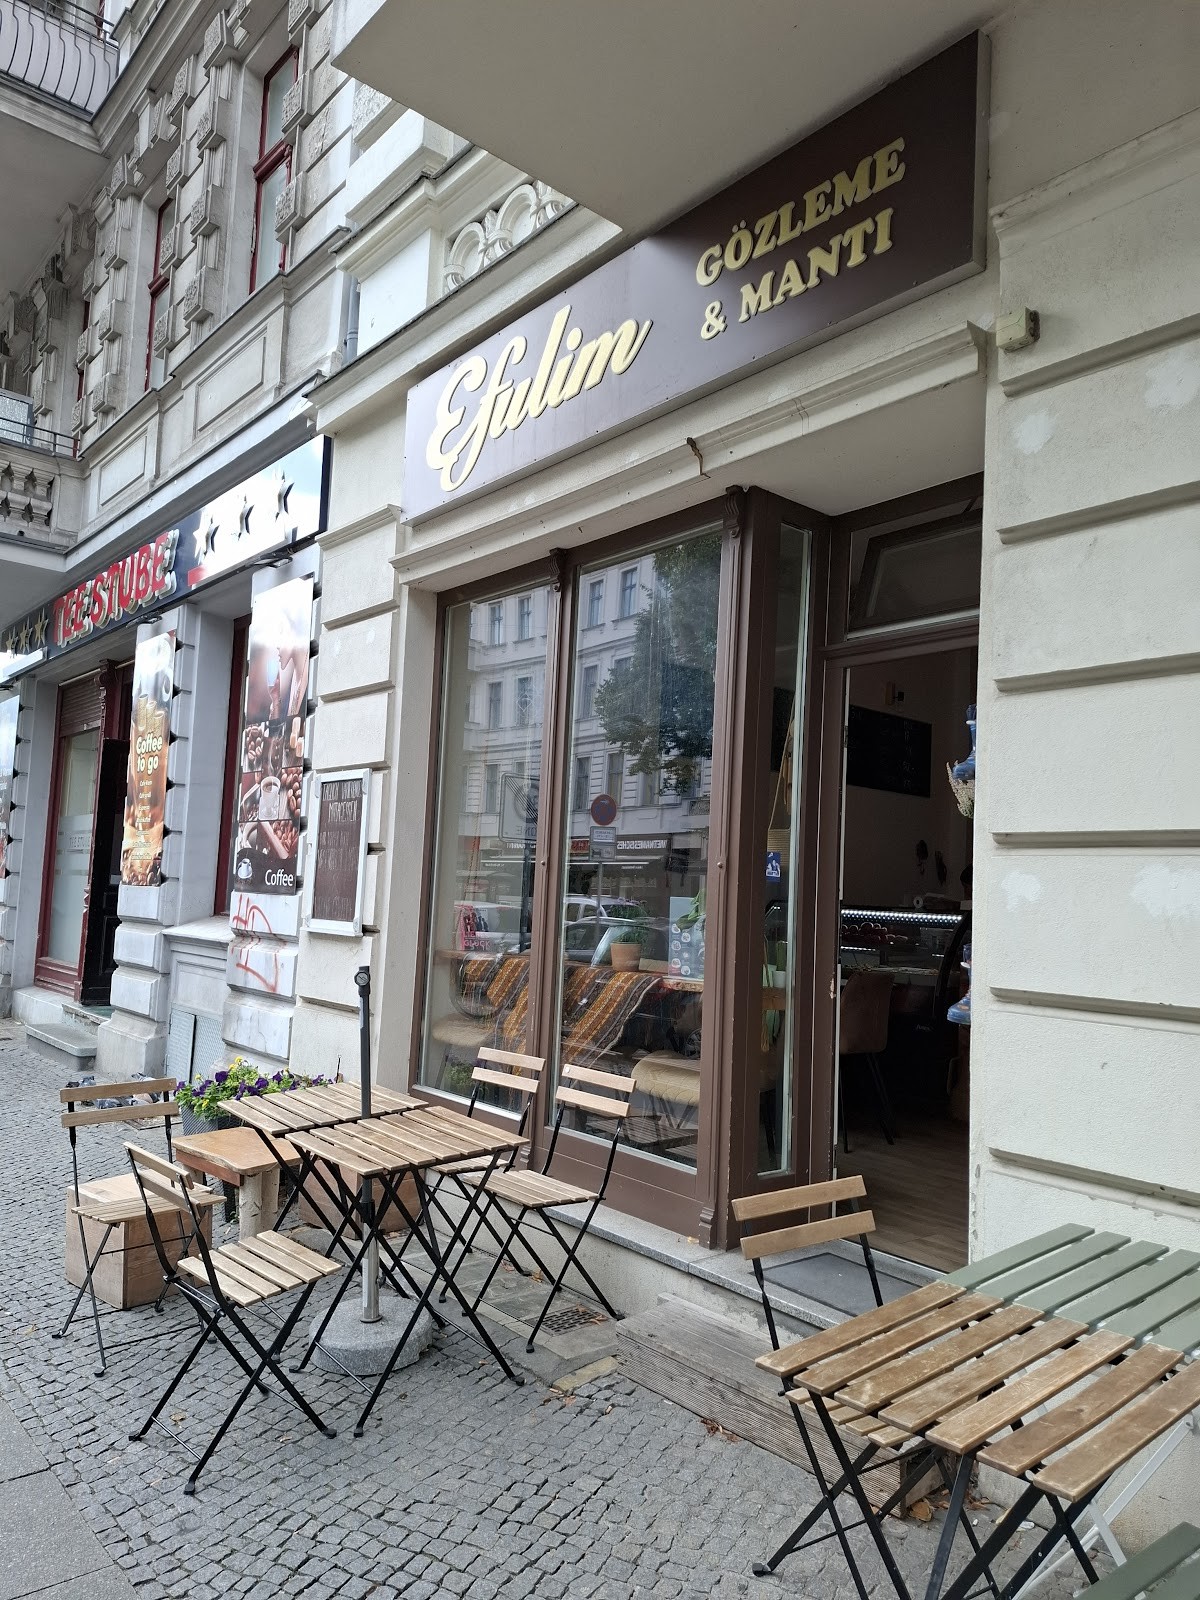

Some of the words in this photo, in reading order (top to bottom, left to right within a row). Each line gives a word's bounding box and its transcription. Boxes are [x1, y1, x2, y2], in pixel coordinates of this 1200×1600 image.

[695, 137, 906, 288] GÖZLEME
[700, 301, 727, 342] &
[738, 207, 895, 323] MANTI
[426, 304, 653, 492] Efulim
[136, 733, 163, 755] Coffee
[138, 756, 146, 772] to
[147, 756, 159, 775] go
[265, 869, 294, 887] Coffee
